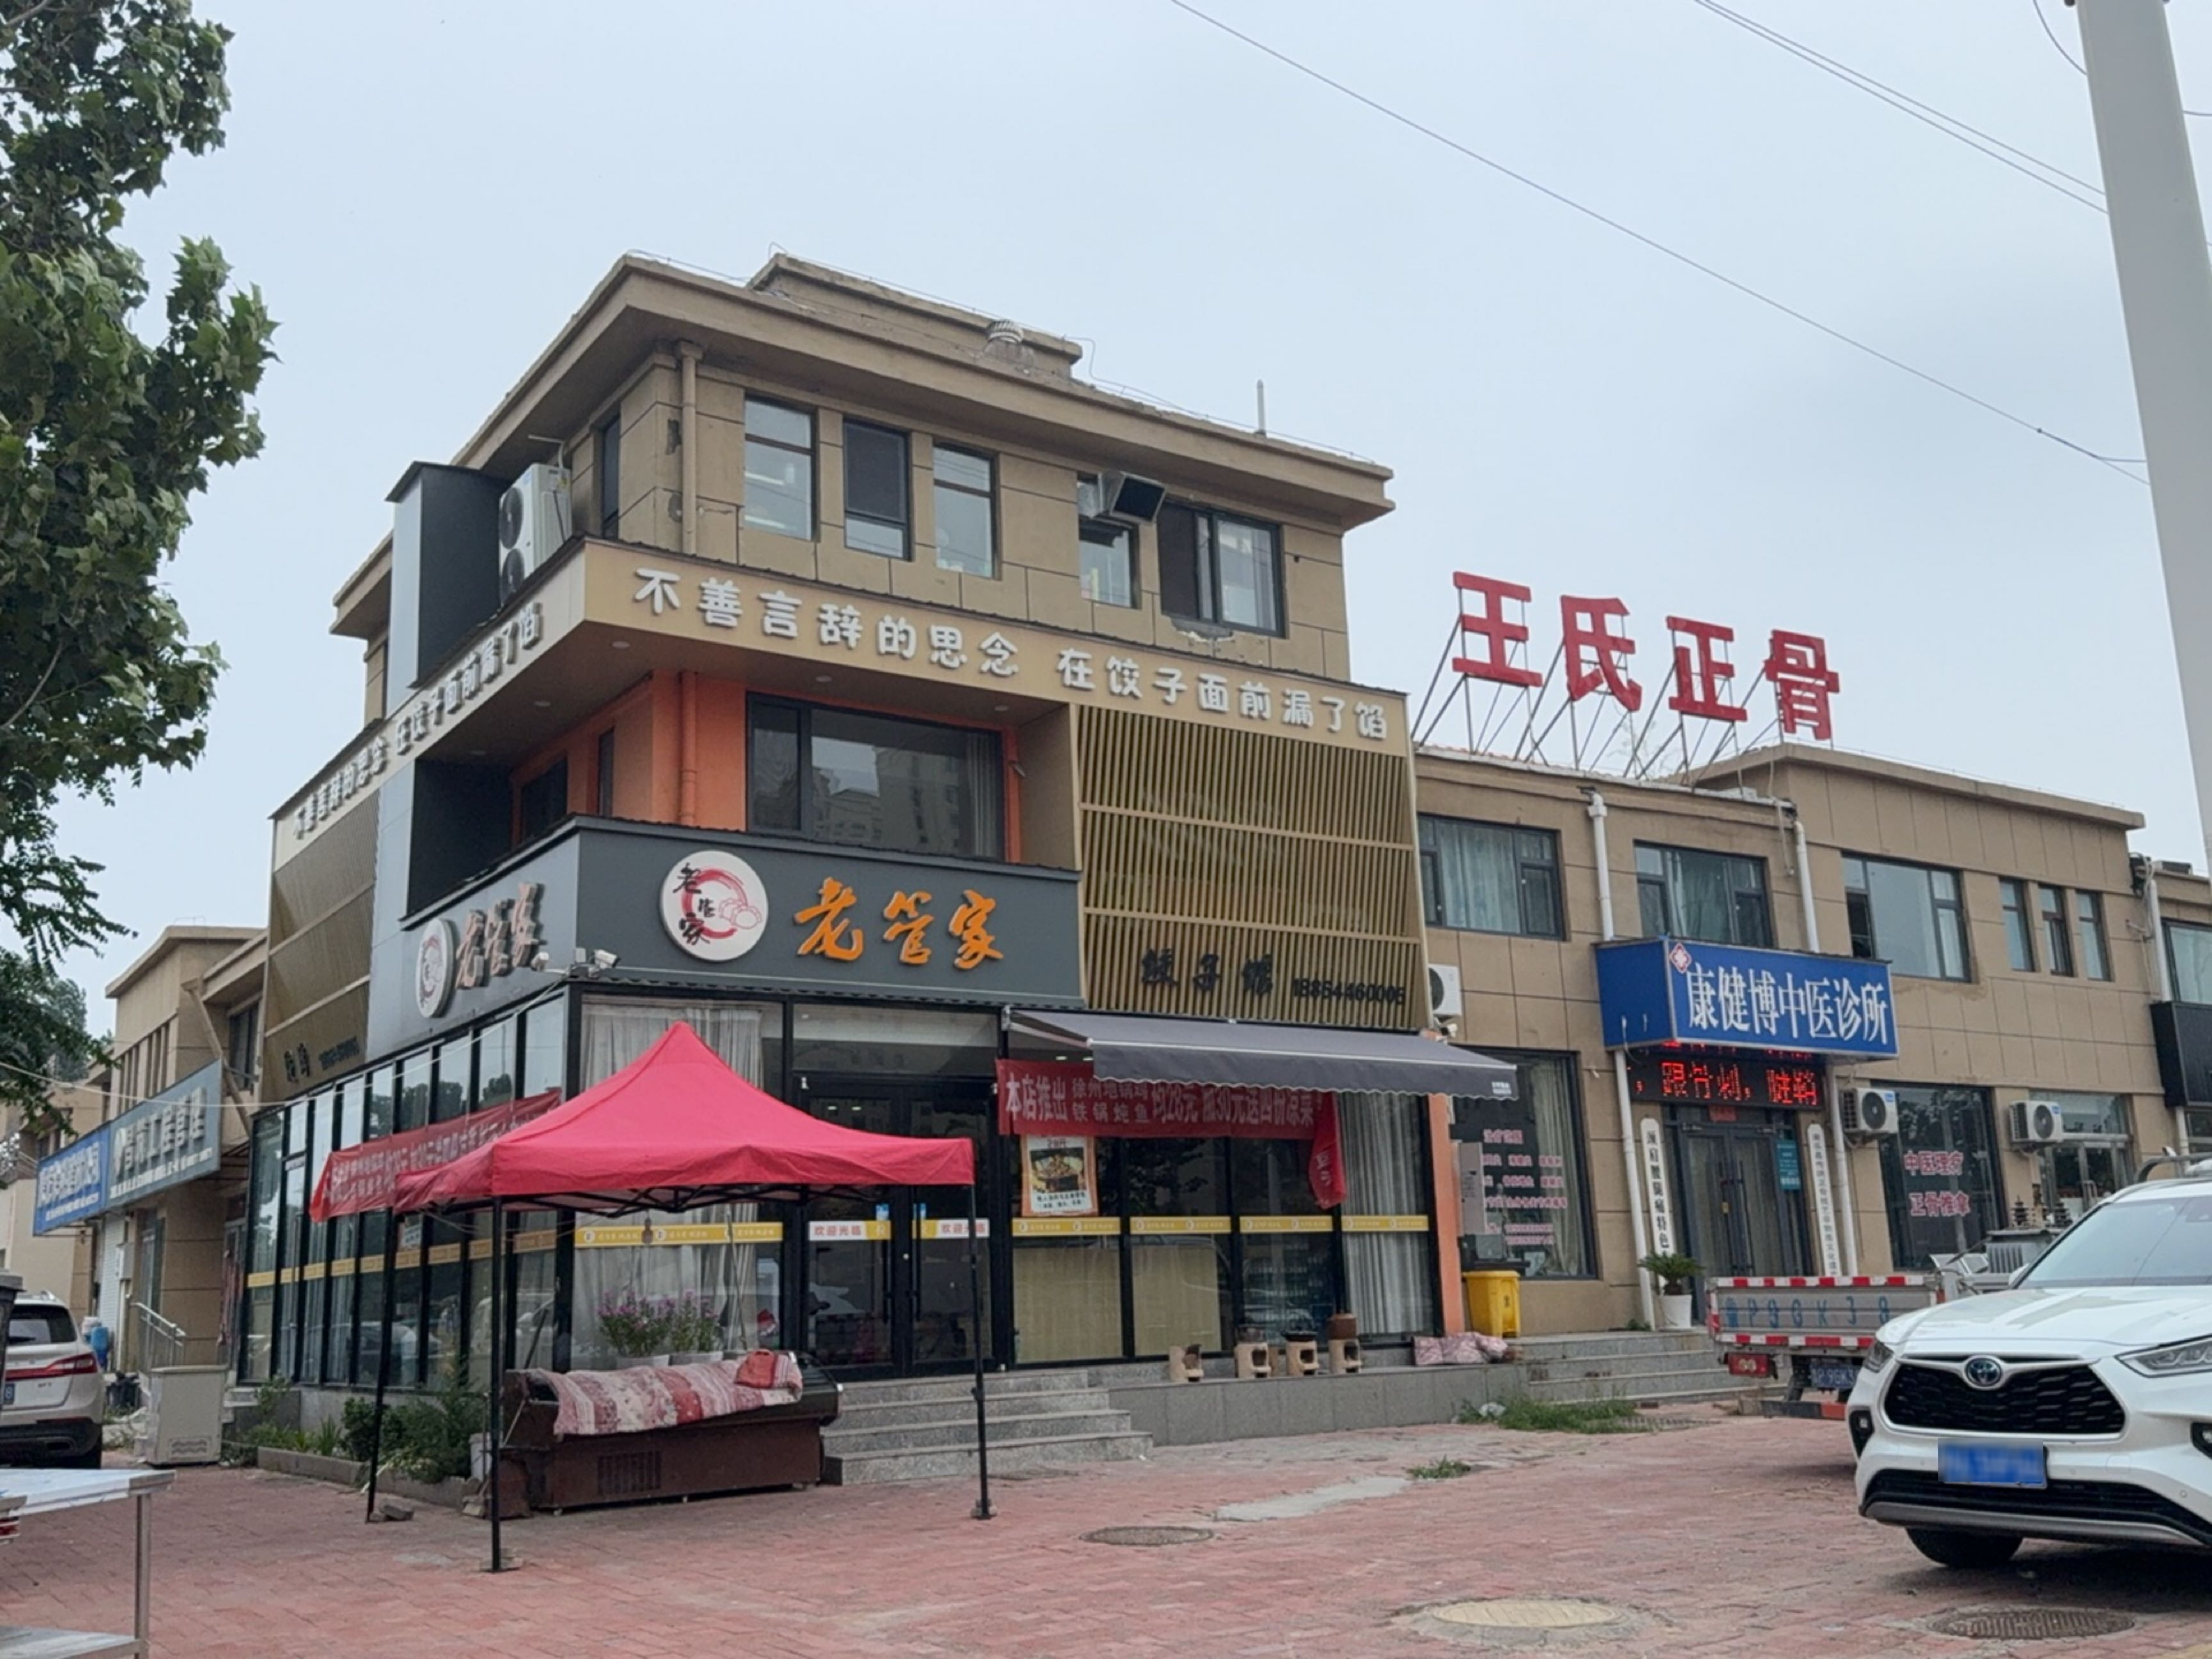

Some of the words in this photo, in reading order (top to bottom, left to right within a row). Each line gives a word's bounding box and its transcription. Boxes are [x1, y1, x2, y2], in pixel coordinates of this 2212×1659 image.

[634, 567, 1019, 677] 不善言辞的思念
[1057, 647, 1388, 741] 在饺子面前漏了馅
[1452, 571, 1839, 740] 王氏正骨
[795, 878, 1003, 969] 老管家
[1687, 963, 1888, 1045] 康健博中医诊所
[1006, 1072, 1068, 1121] 本店推出
[813, 1225, 862, 1236] 欢迎光临
